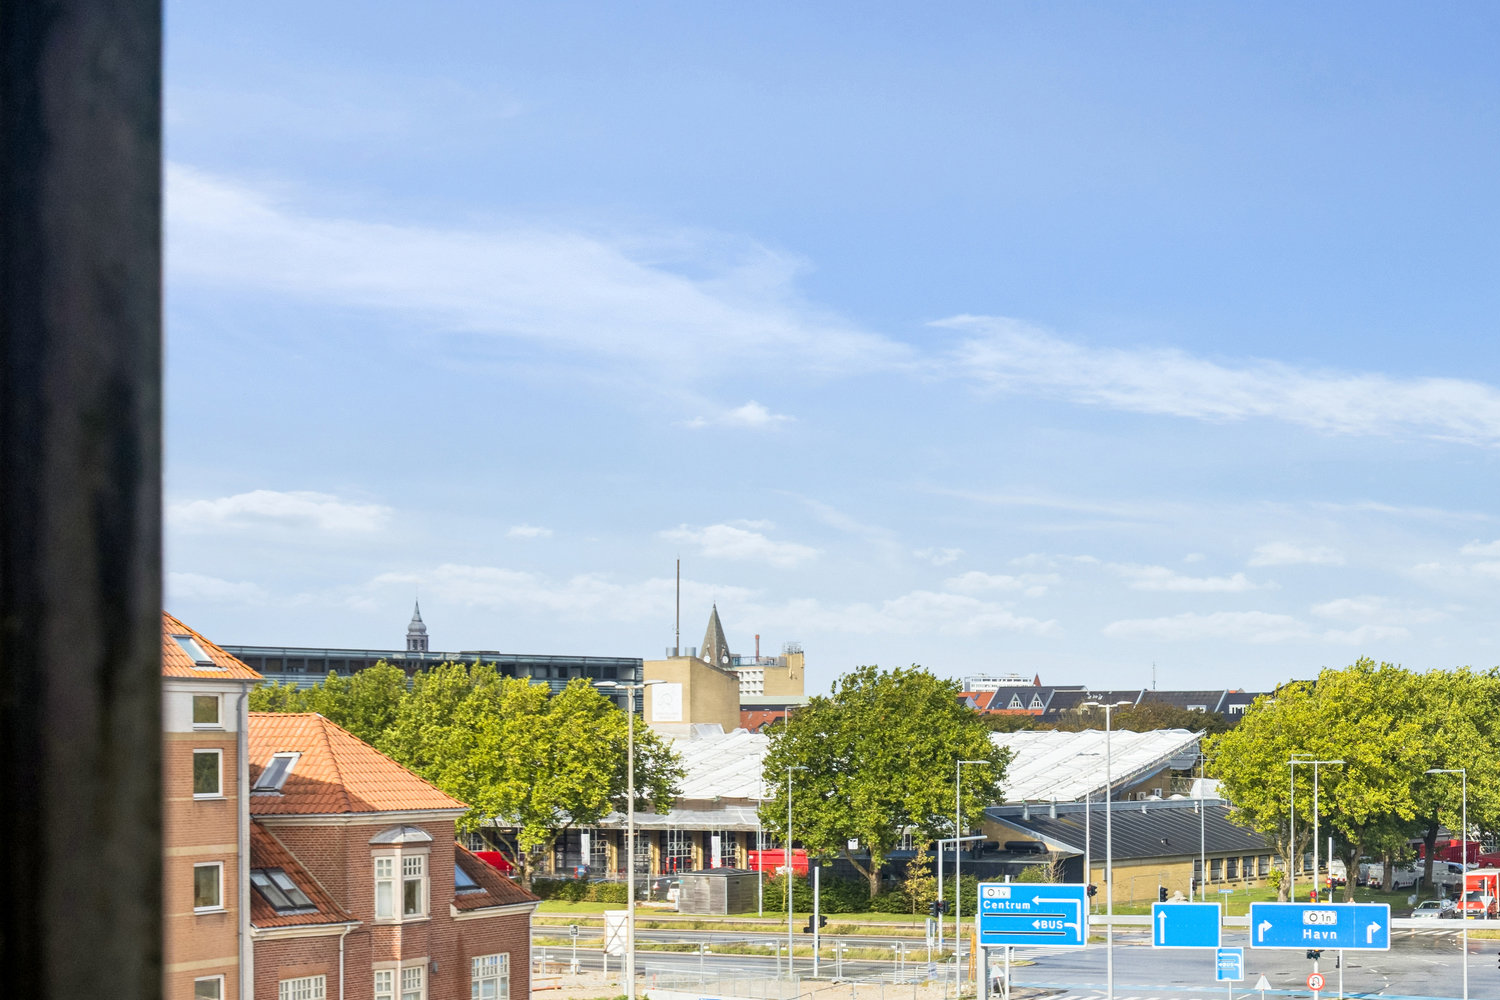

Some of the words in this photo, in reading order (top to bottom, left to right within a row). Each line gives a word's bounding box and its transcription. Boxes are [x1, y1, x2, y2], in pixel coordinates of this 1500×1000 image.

[983, 900, 1031, 910] Centrum
[1041, 920, 1063, 930] BUS
[1303, 929, 1337, 939] Havn
